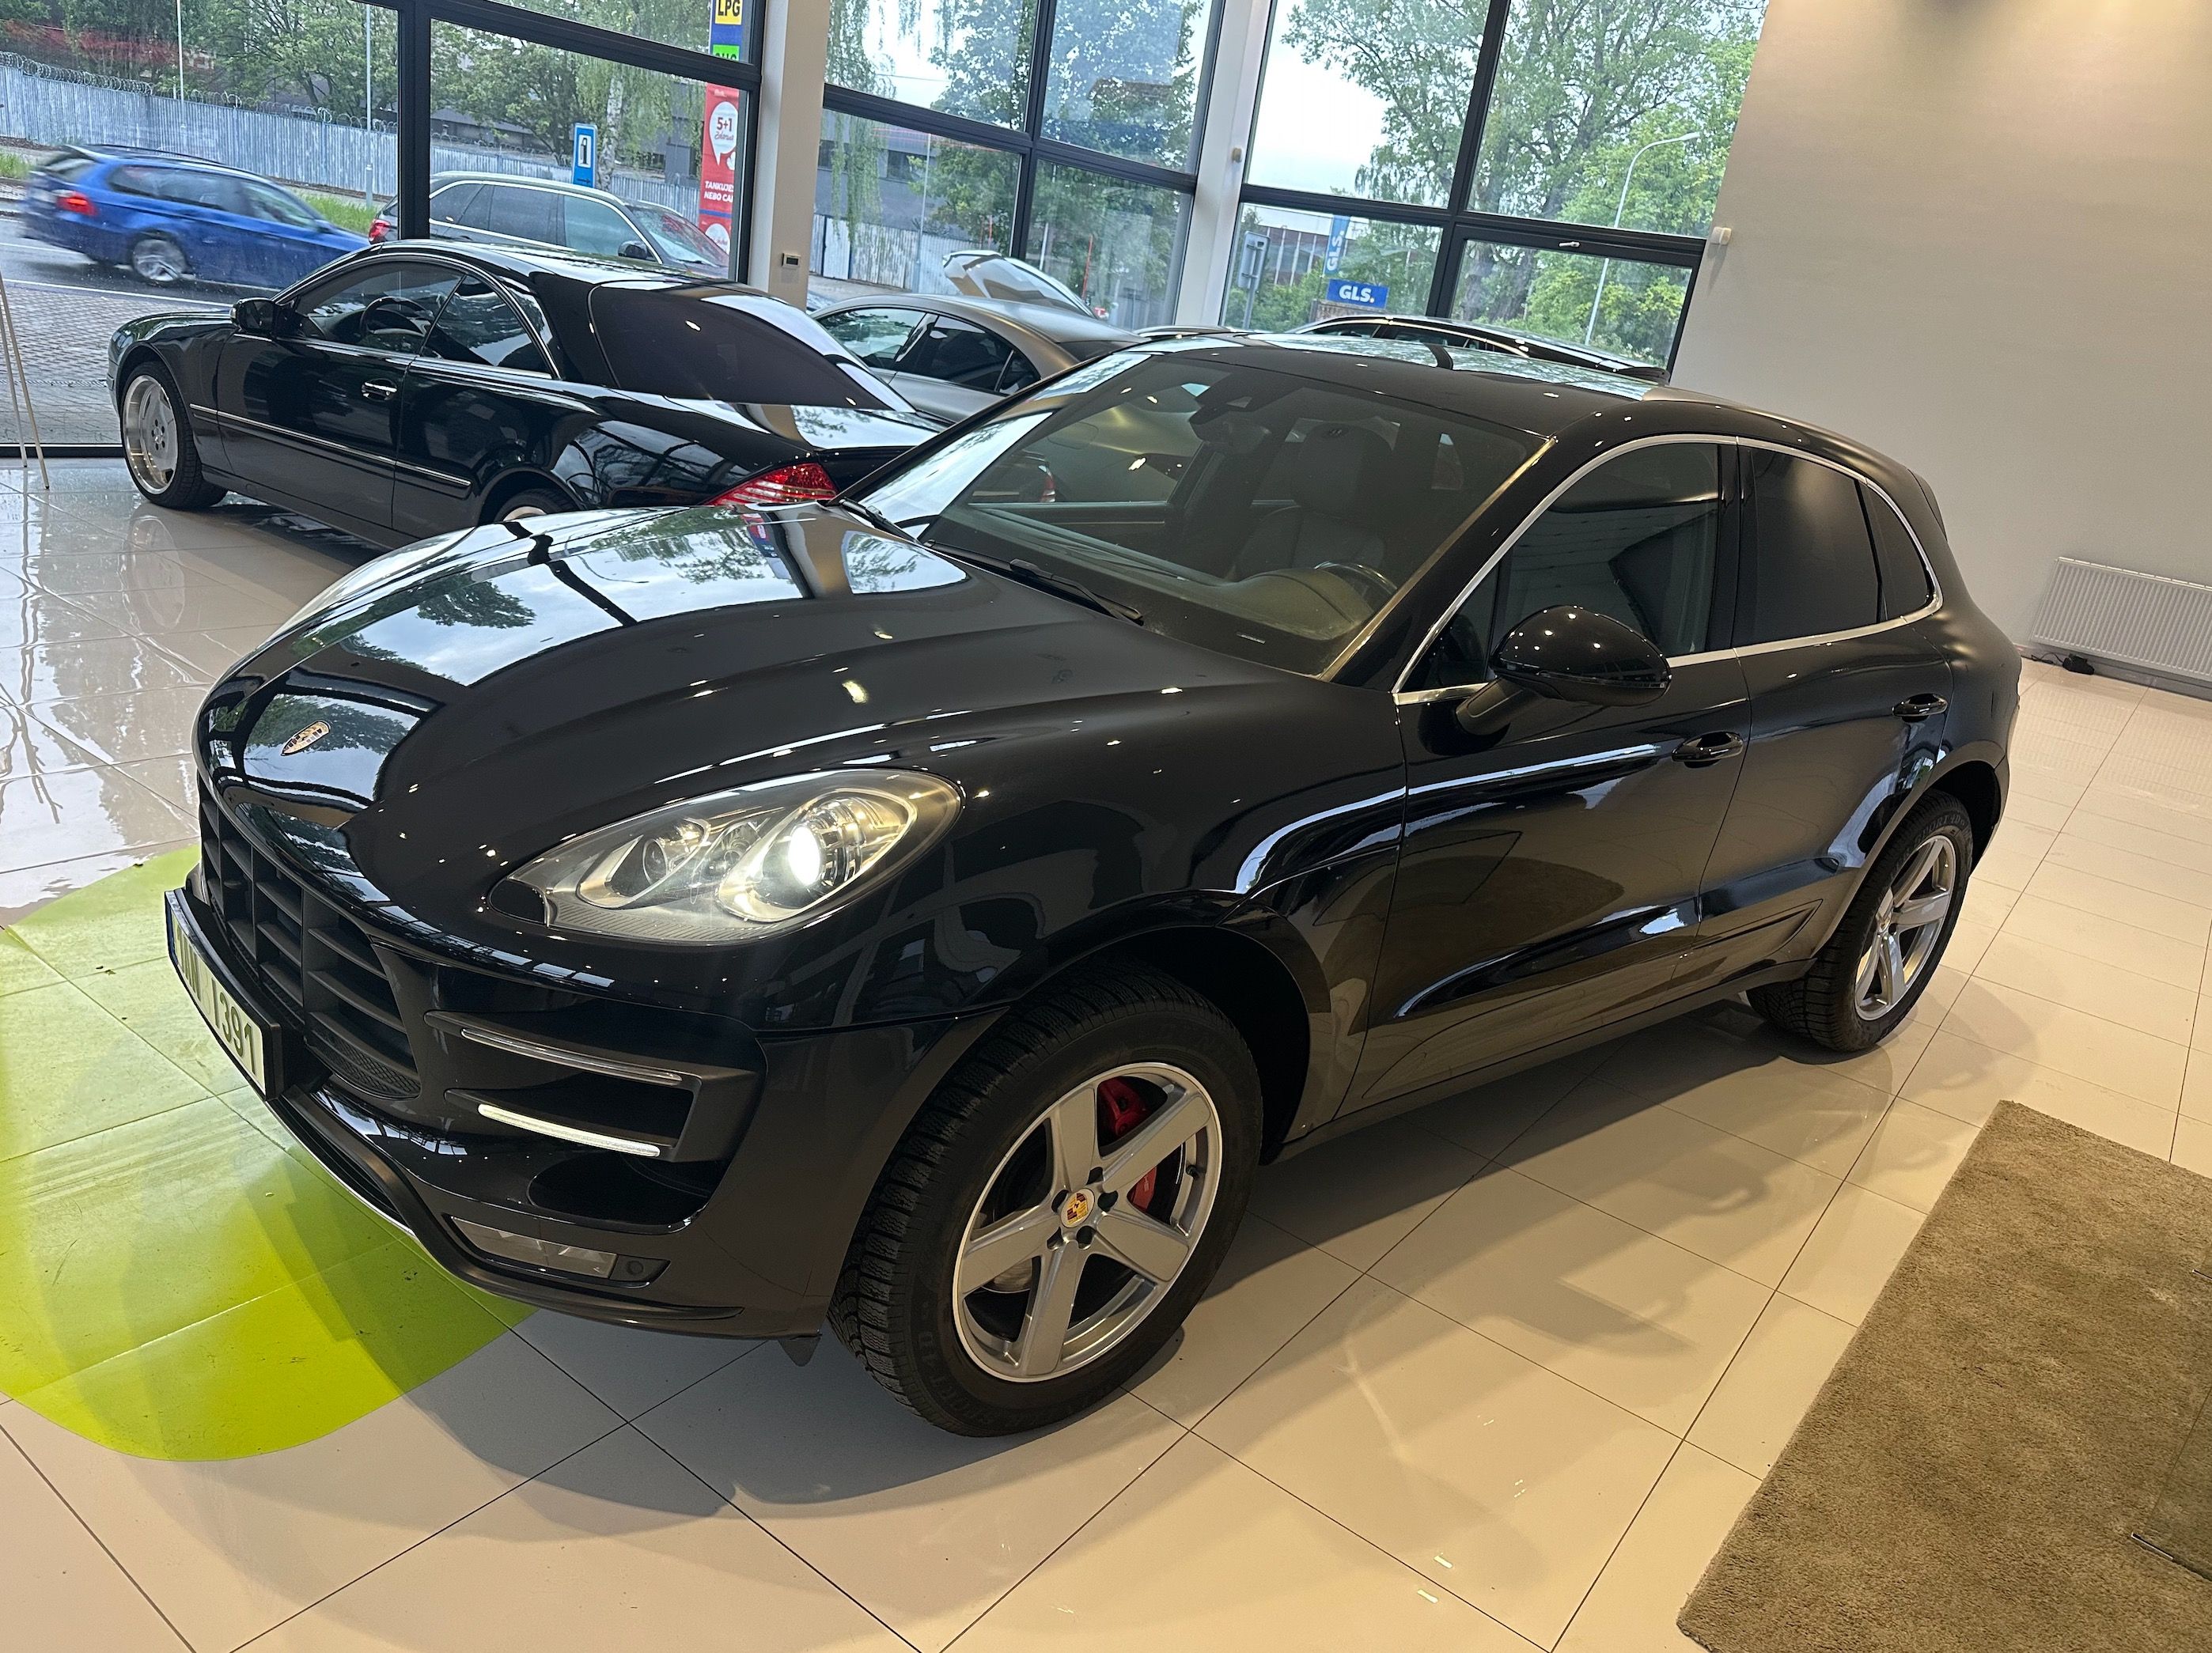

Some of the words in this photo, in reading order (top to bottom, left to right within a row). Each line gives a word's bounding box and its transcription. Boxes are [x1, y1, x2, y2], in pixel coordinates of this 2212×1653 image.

[718, 0, 740, 17] LPG
[716, 117, 733, 131] 5+1
[703, 191, 722, 201] NEBO
[1327, 231, 1345, 270] GLS.
[1339, 285, 1375, 303] GLS.
[210, 978, 257, 1076] 1391
